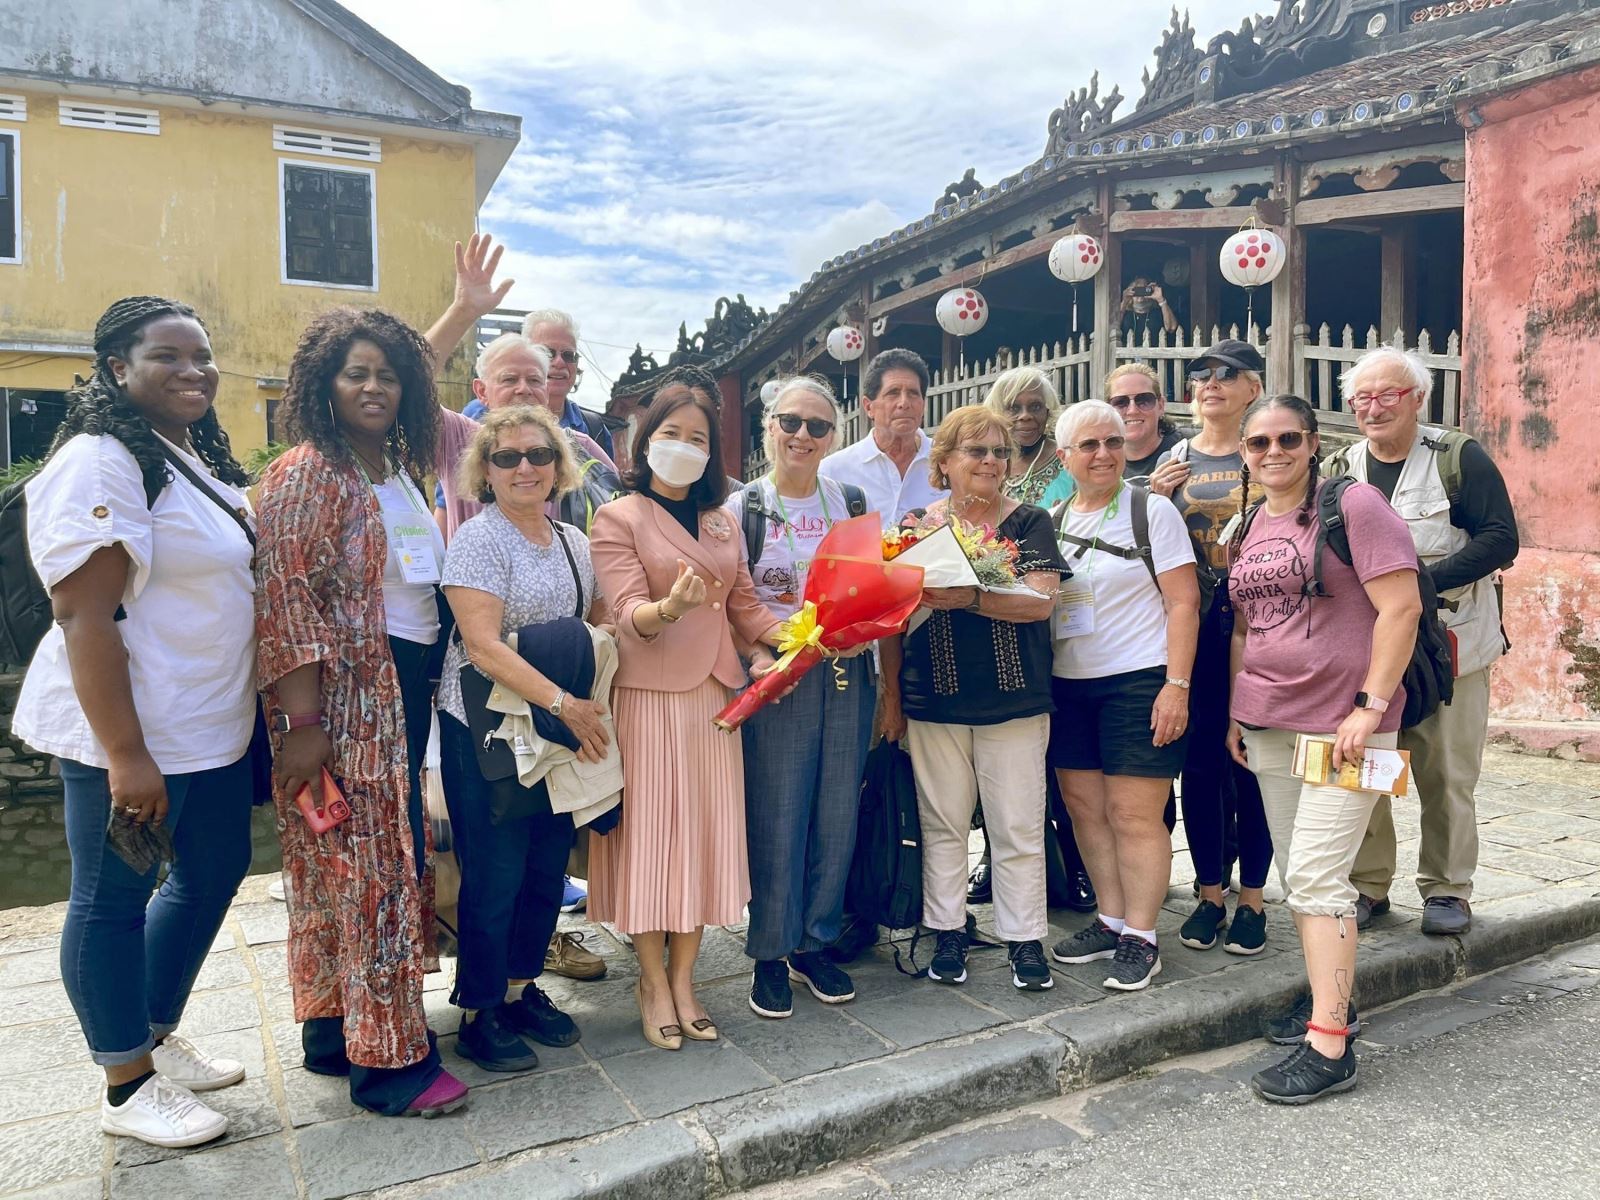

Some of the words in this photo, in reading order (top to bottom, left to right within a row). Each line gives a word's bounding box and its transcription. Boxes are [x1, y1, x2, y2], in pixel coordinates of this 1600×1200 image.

[1188, 470, 1242, 484] GARD
[1229, 555, 1309, 592] Sweet
[1237, 583, 1286, 603] SORTA
